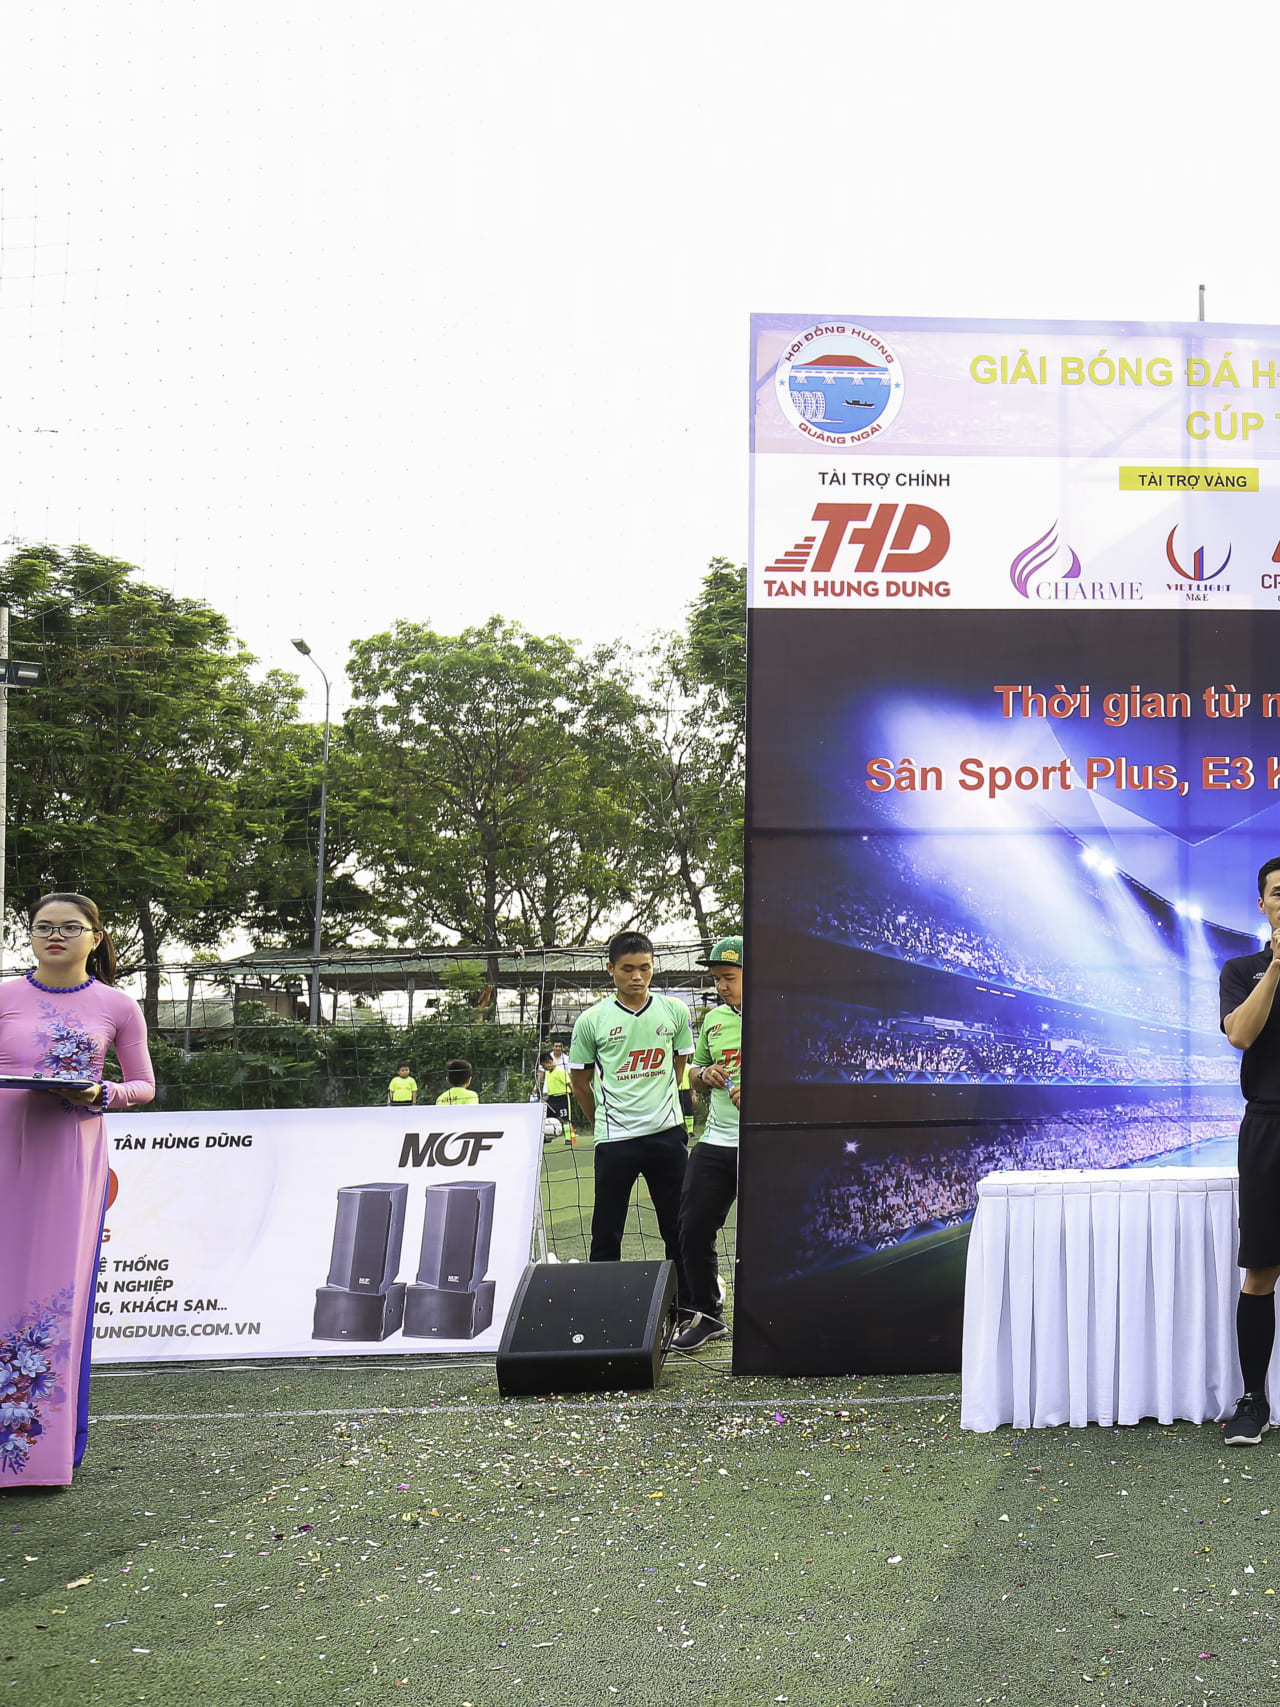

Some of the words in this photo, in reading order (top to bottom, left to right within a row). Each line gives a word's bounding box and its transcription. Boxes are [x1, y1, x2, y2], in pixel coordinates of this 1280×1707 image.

[969, 348, 1046, 385] GIẢI
[1061, 349, 1173, 387] BÓNG
[1184, 352, 1240, 387] ĐÁ
[1186, 404, 1264, 440] CÚP
[818, 469, 846, 485] TÀI
[852, 473, 890, 489] TRỢ
[895, 470, 950, 487] CHÍNH
[1138, 473, 1163, 487] TÀI
[1167, 475, 1200, 489] TRỢ
[1203, 473, 1247, 488] VÀNG
[763, 580, 806, 597] TAN
[814, 580, 879, 597] HUNG
[886, 581, 951, 598] DUNG
[1036, 581, 1143, 600] CHARME
[993, 684, 1090, 719] Thời
[1103, 684, 1191, 727] gian
[1202, 684, 1252, 719] từ
[865, 757, 943, 791] Sân
[958, 757, 1073, 798] Sport
[1085, 757, 1191, 796] Plus,
[1201, 757, 1255, 790] E3
[113, 1134, 146, 1151] TÂN
[152, 1133, 199, 1149] HÙNG
[205, 1132, 253, 1148] DŨNG
[398, 1131, 504, 1168] MOF
[113, 1254, 169, 1272] THỐNG
[113, 1276, 173, 1294] NGHIỆP
[120, 1297, 178, 1313] KHÁCH
[92, 1322, 261, 1339] UNGDUNG.COM.VN
